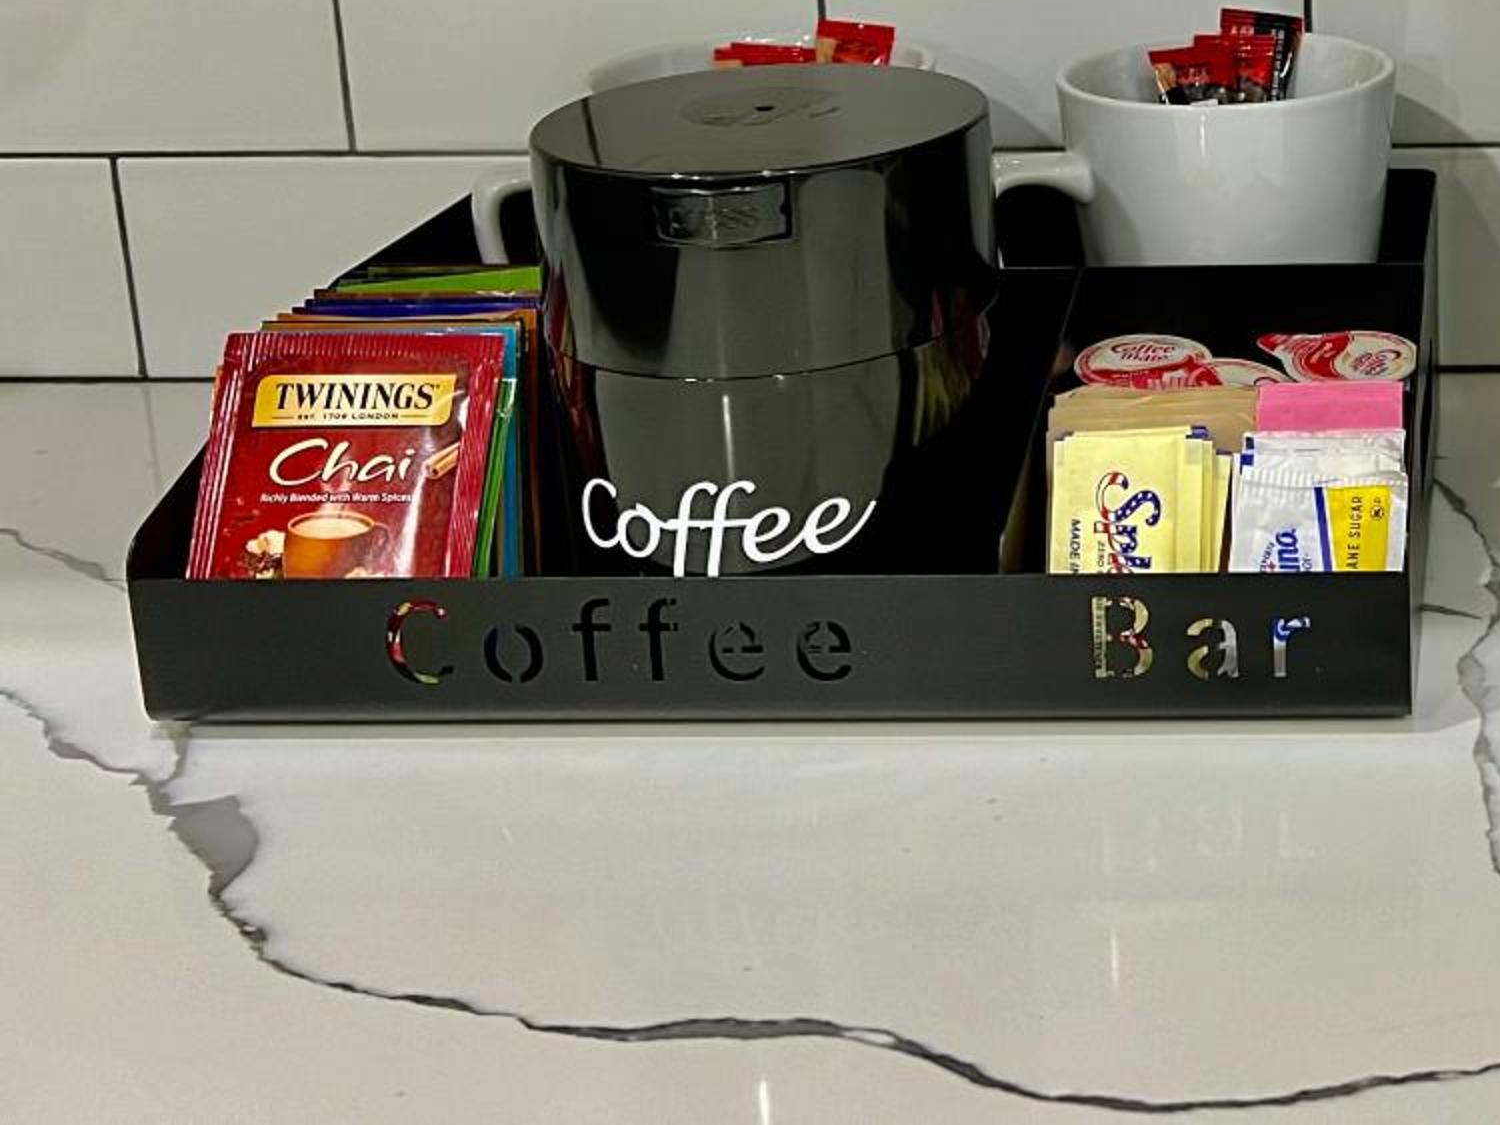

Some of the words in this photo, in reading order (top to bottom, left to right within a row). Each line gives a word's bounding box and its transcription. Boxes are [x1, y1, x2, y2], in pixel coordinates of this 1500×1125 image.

[1111, 342, 1176, 355] Coffee
[275, 382, 435, 410] TWININGS
[351, 412, 399, 420] LONDON
[269, 438, 416, 486] Chai
[260, 493, 289, 504] Richly
[289, 493, 329, 503] Blended
[329, 493, 351, 502] with
[352, 493, 380, 502] Warm
[1348, 496, 1364, 539] SUGAR
[582, 478, 877, 578] Coffee
[1069, 518, 1082, 560] MADE
[386, 598, 854, 683] Coffee
[1091, 596, 1311, 678] Bar
